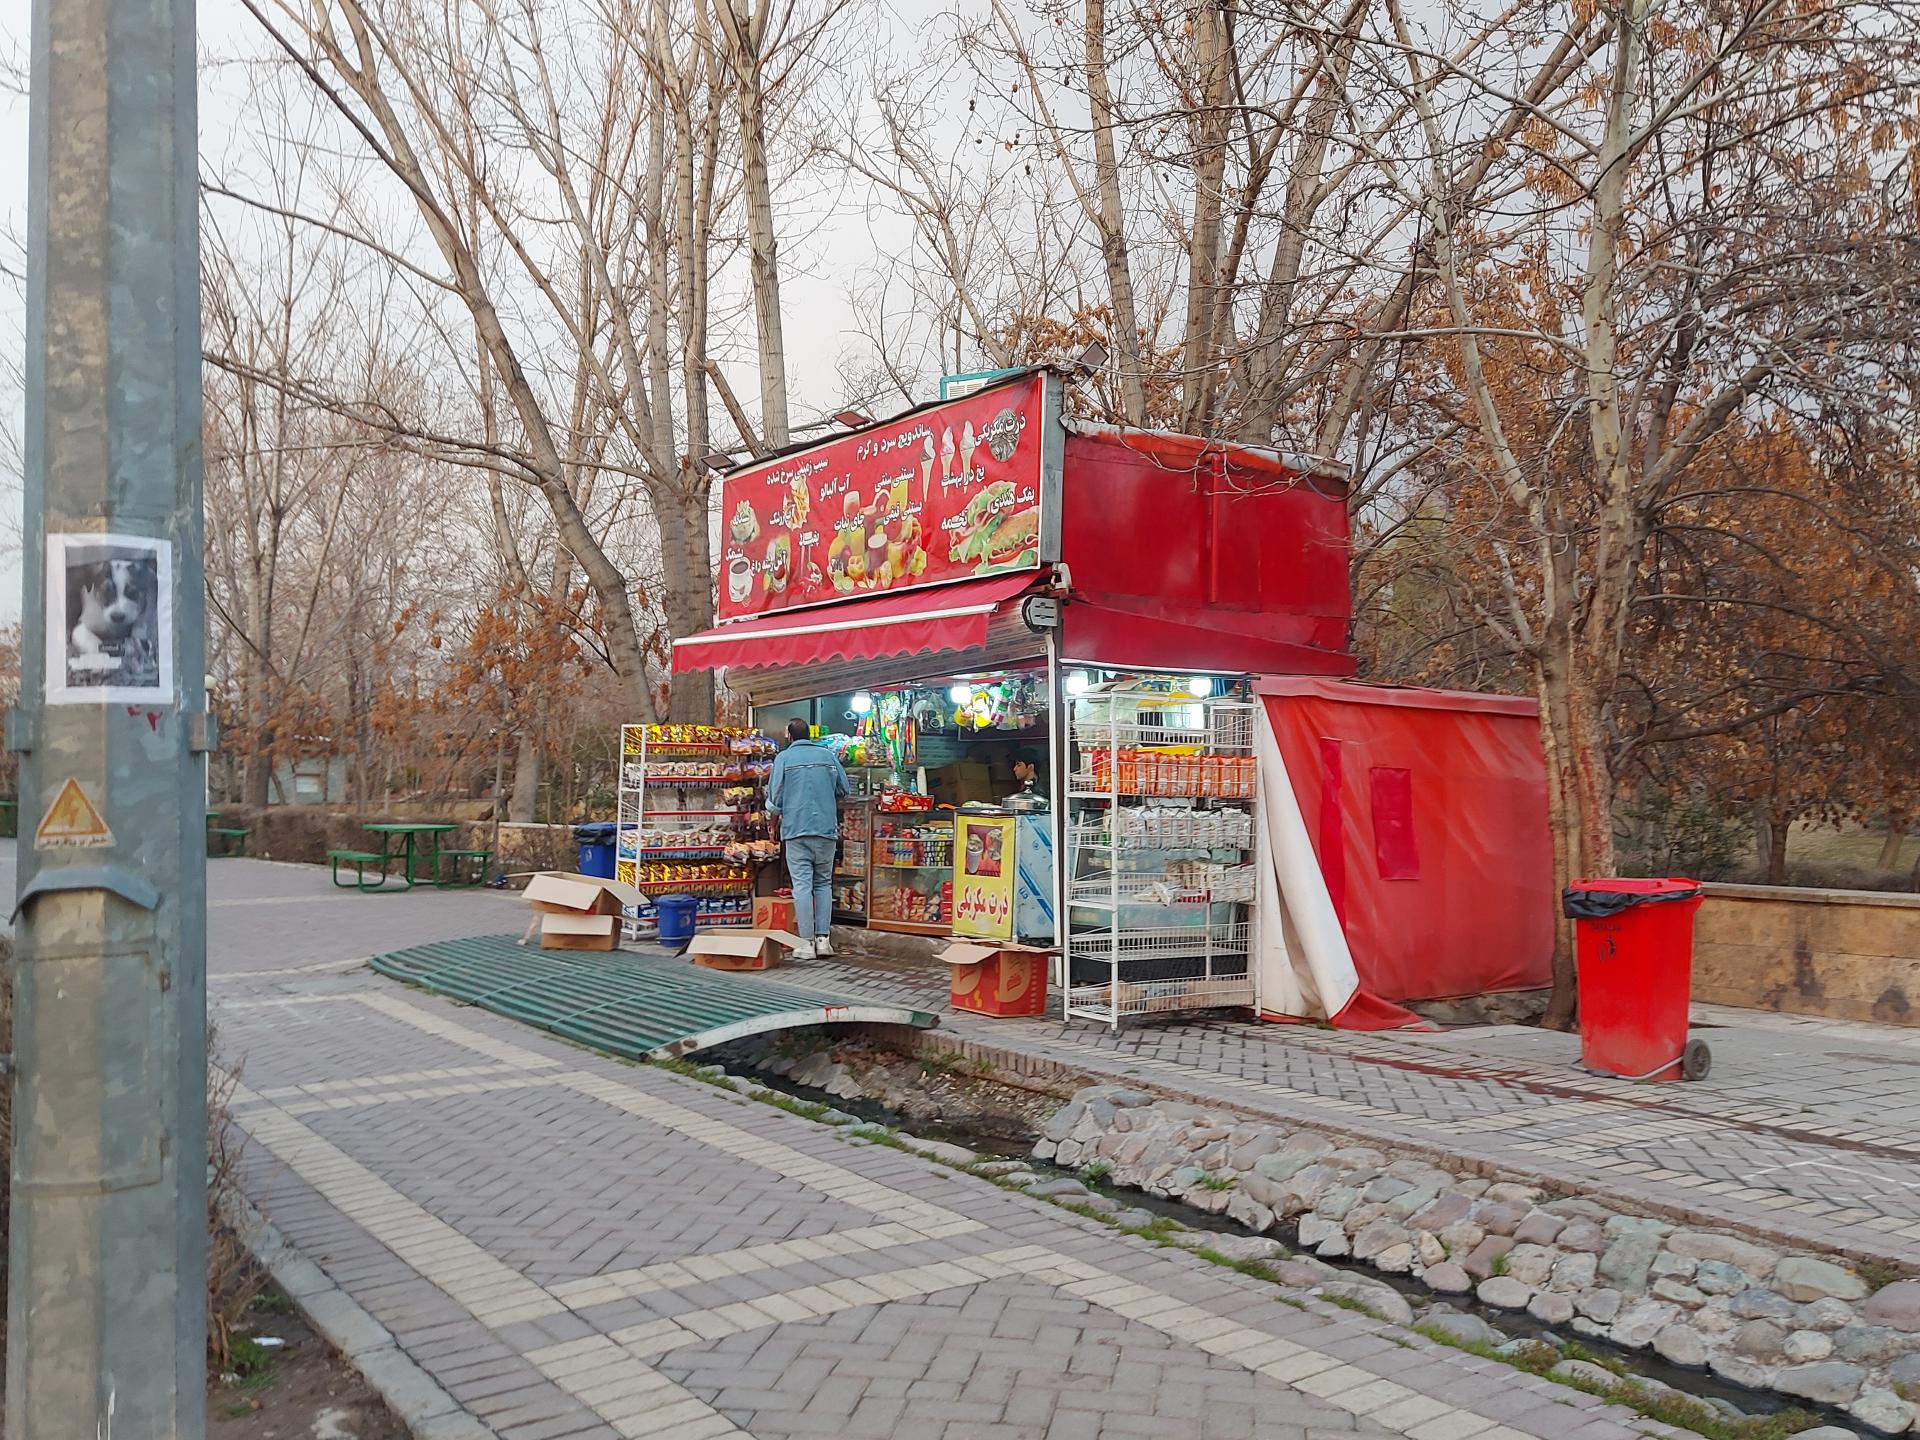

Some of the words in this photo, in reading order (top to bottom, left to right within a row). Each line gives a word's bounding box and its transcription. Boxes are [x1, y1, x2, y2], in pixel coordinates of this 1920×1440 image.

[1005, 411, 1026, 434] ذرت
[898, 424, 934, 448] ساندویچ
[974, 421, 1006, 447] مکزیکی
[872, 442, 879, 457] و
[881, 438, 897, 453] سرد
[780, 468, 794, 484] سرخ
[794, 460, 813, 481] زمینی
[813, 459, 829, 474] سیب
[976, 464, 985, 483] یخ
[766, 470, 780, 486] شده
[838, 473, 851, 495] آب
[874, 473, 892, 493] سنتی
[892, 468, 915, 488] بستنی
[941, 471, 964, 488] بهشت
[963, 469, 975, 487] در
[819, 478, 838, 502] آلبالو
[1017, 487, 1035, 506] پفک
[901, 501, 923, 520] بستنی
[990, 488, 1016, 515] هندی
[769, 511, 786, 526] زرشک
[834, 514, 850, 533] نبات
[850, 512, 865, 532] چای
[883, 502, 900, 526] قیفی
[941, 509, 969, 530] تخمه
[726, 548, 744, 561] پشمک
[774, 551, 787, 571] آش
[750, 559, 762, 577] داغ
[956, 885, 986, 921] مکزیکی
[988, 887, 1009, 925] ذرت
